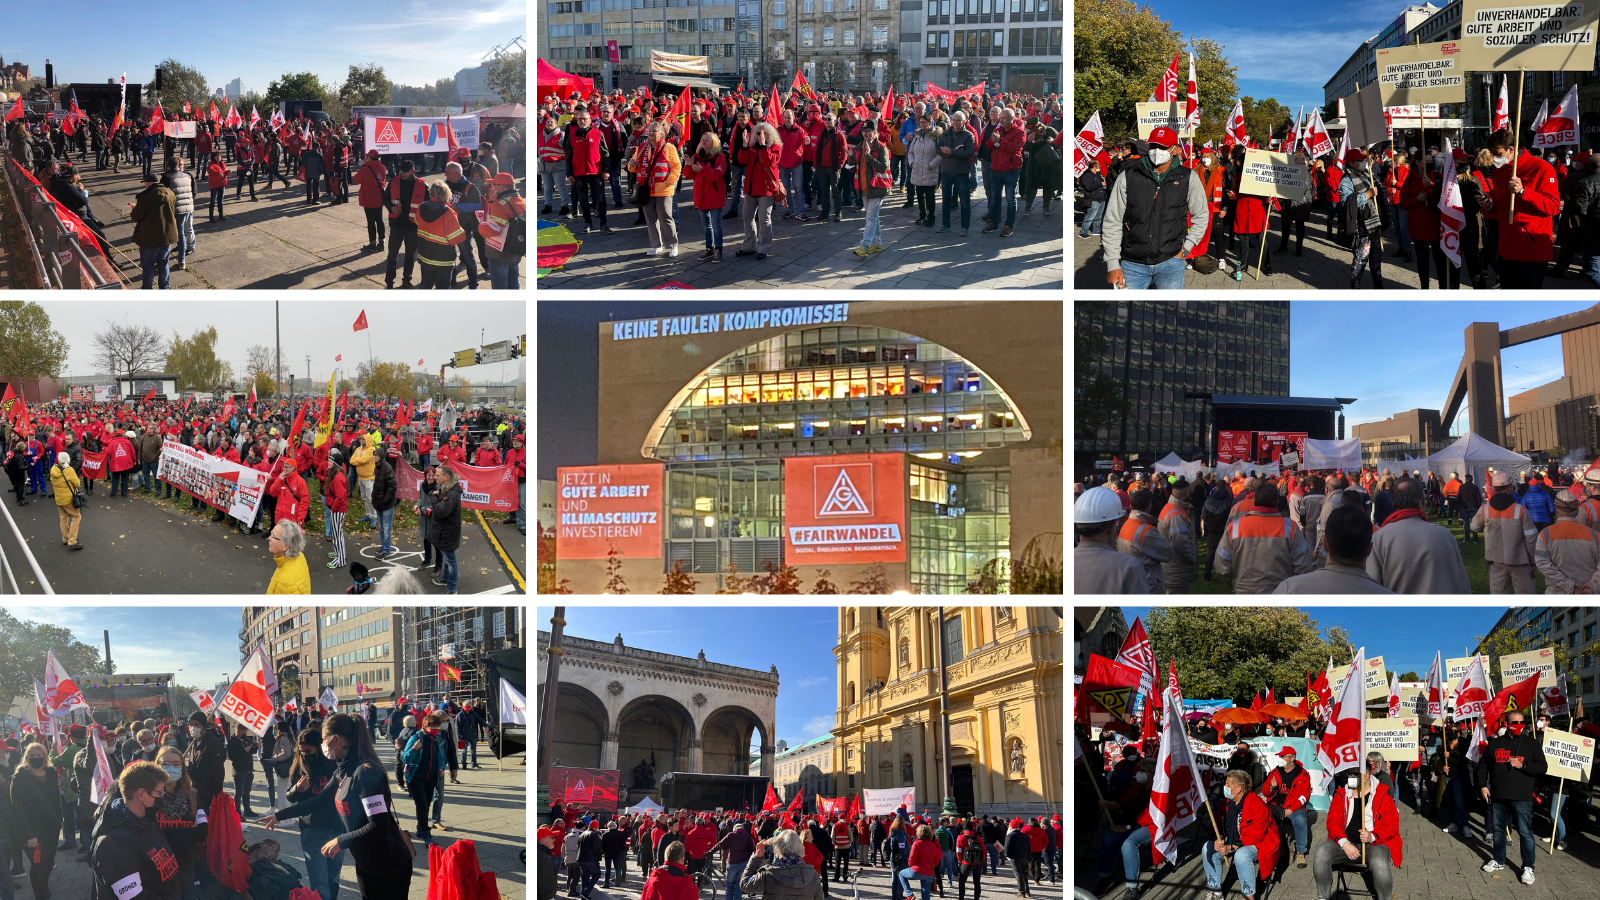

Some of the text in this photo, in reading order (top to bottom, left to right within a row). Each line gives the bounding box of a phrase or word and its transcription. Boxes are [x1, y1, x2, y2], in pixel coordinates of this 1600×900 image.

[1477, 6, 1581, 22] UNVERHANDELBAR:
[1466, 20, 1563, 35] GUTE ARBEIT UND
[1486, 31, 1590, 46] SOZIALER SCHUTZ!
[1387, 60, 1453, 73] UNVERHANDELBAR:
[1381, 70, 1442, 82] GUTE ARBEIT UND
[1395, 77, 1461, 89] SOZIALER SCHUTZ!
[1140, 116, 1187, 125] TRANSFORMATIO
[1149, 110, 1168, 118] KEINE
[613, 303, 849, 341] KEINE FAULEN KOMPROMISSE!
[562, 472, 610, 487] JETZT IN
[562, 485, 650, 498] GUTE ARBEIT
[562, 499, 588, 512] UND
[561, 511, 658, 525] KLIMASCHUTZ
[562, 525, 642, 539] INVESTIEREN!
[794, 527, 896, 542] #FAIRWANDEL
[1511, 660, 1528, 669] KEINE
[1549, 739, 1579, 753] MIT GUTER
[1559, 758, 1570, 767] MIT
[118, 881, 138, 895] ORDNER
